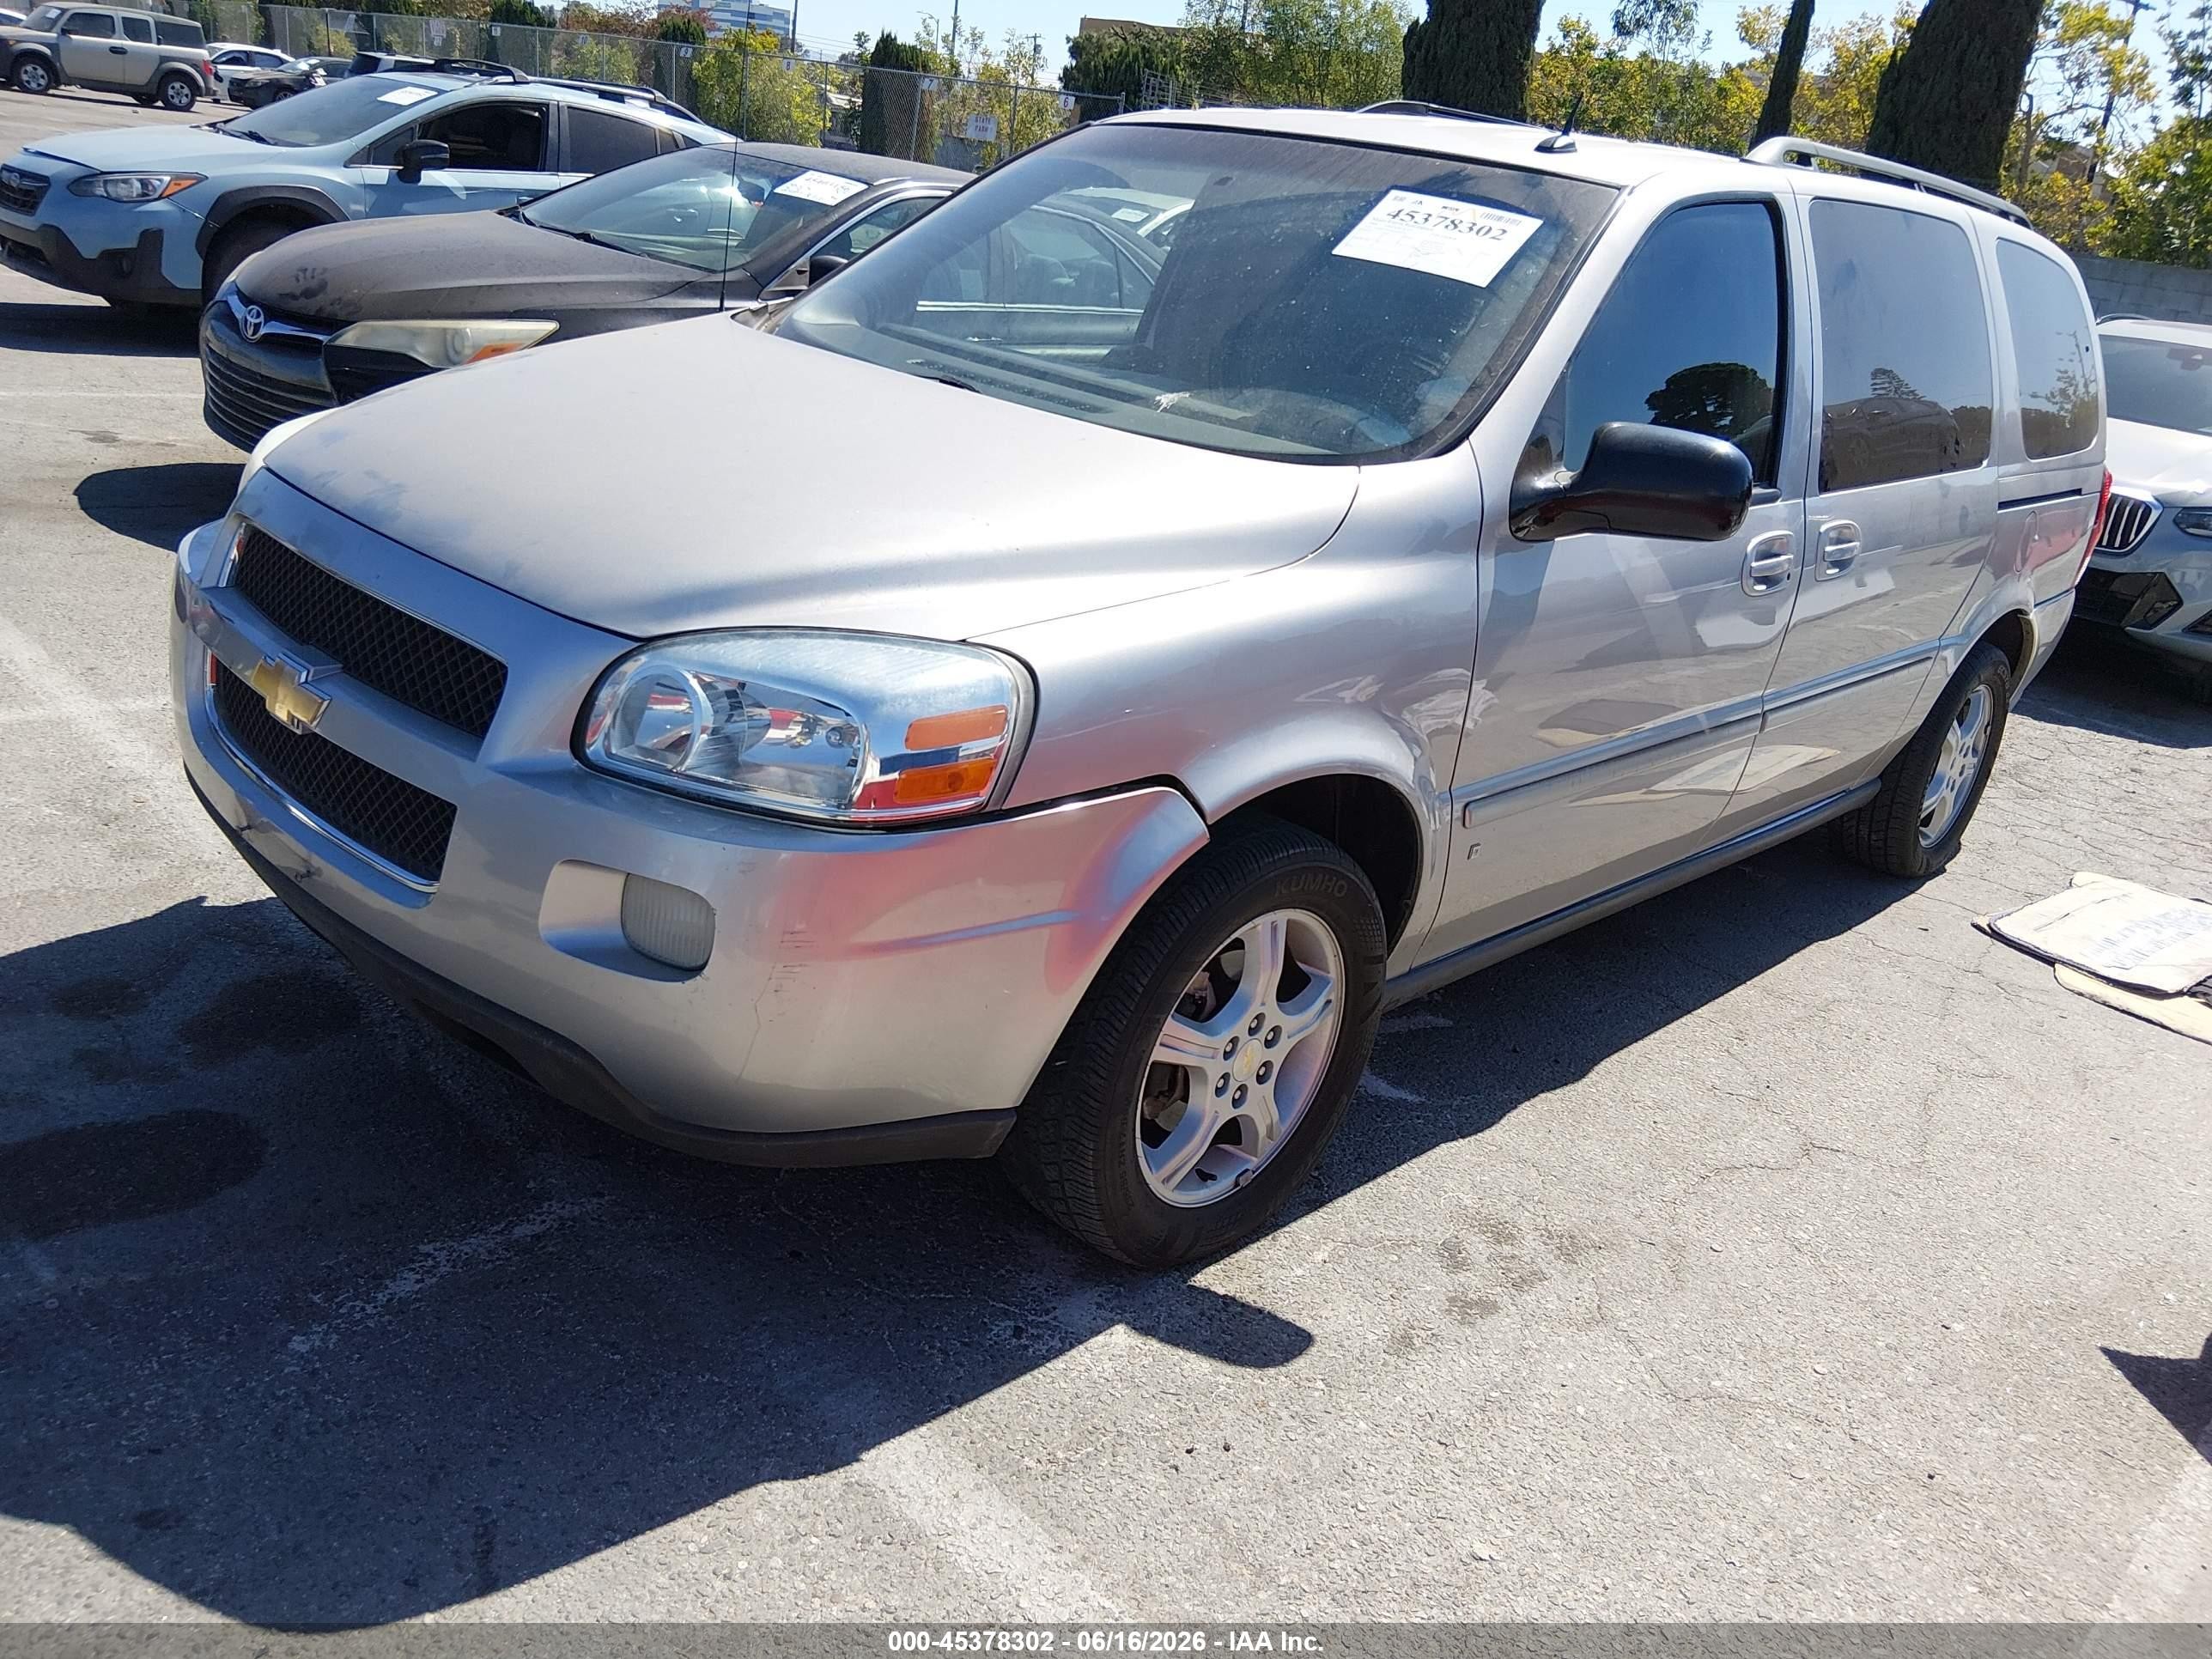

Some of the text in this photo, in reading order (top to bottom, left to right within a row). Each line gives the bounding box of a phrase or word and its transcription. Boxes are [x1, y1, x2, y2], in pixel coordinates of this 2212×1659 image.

[927, 78, 934, 89] 7
[1063, 96, 1069, 108] 6
[1388, 208, 1507, 240] 45378302
[1274, 872, 1347, 897] KUMHO
